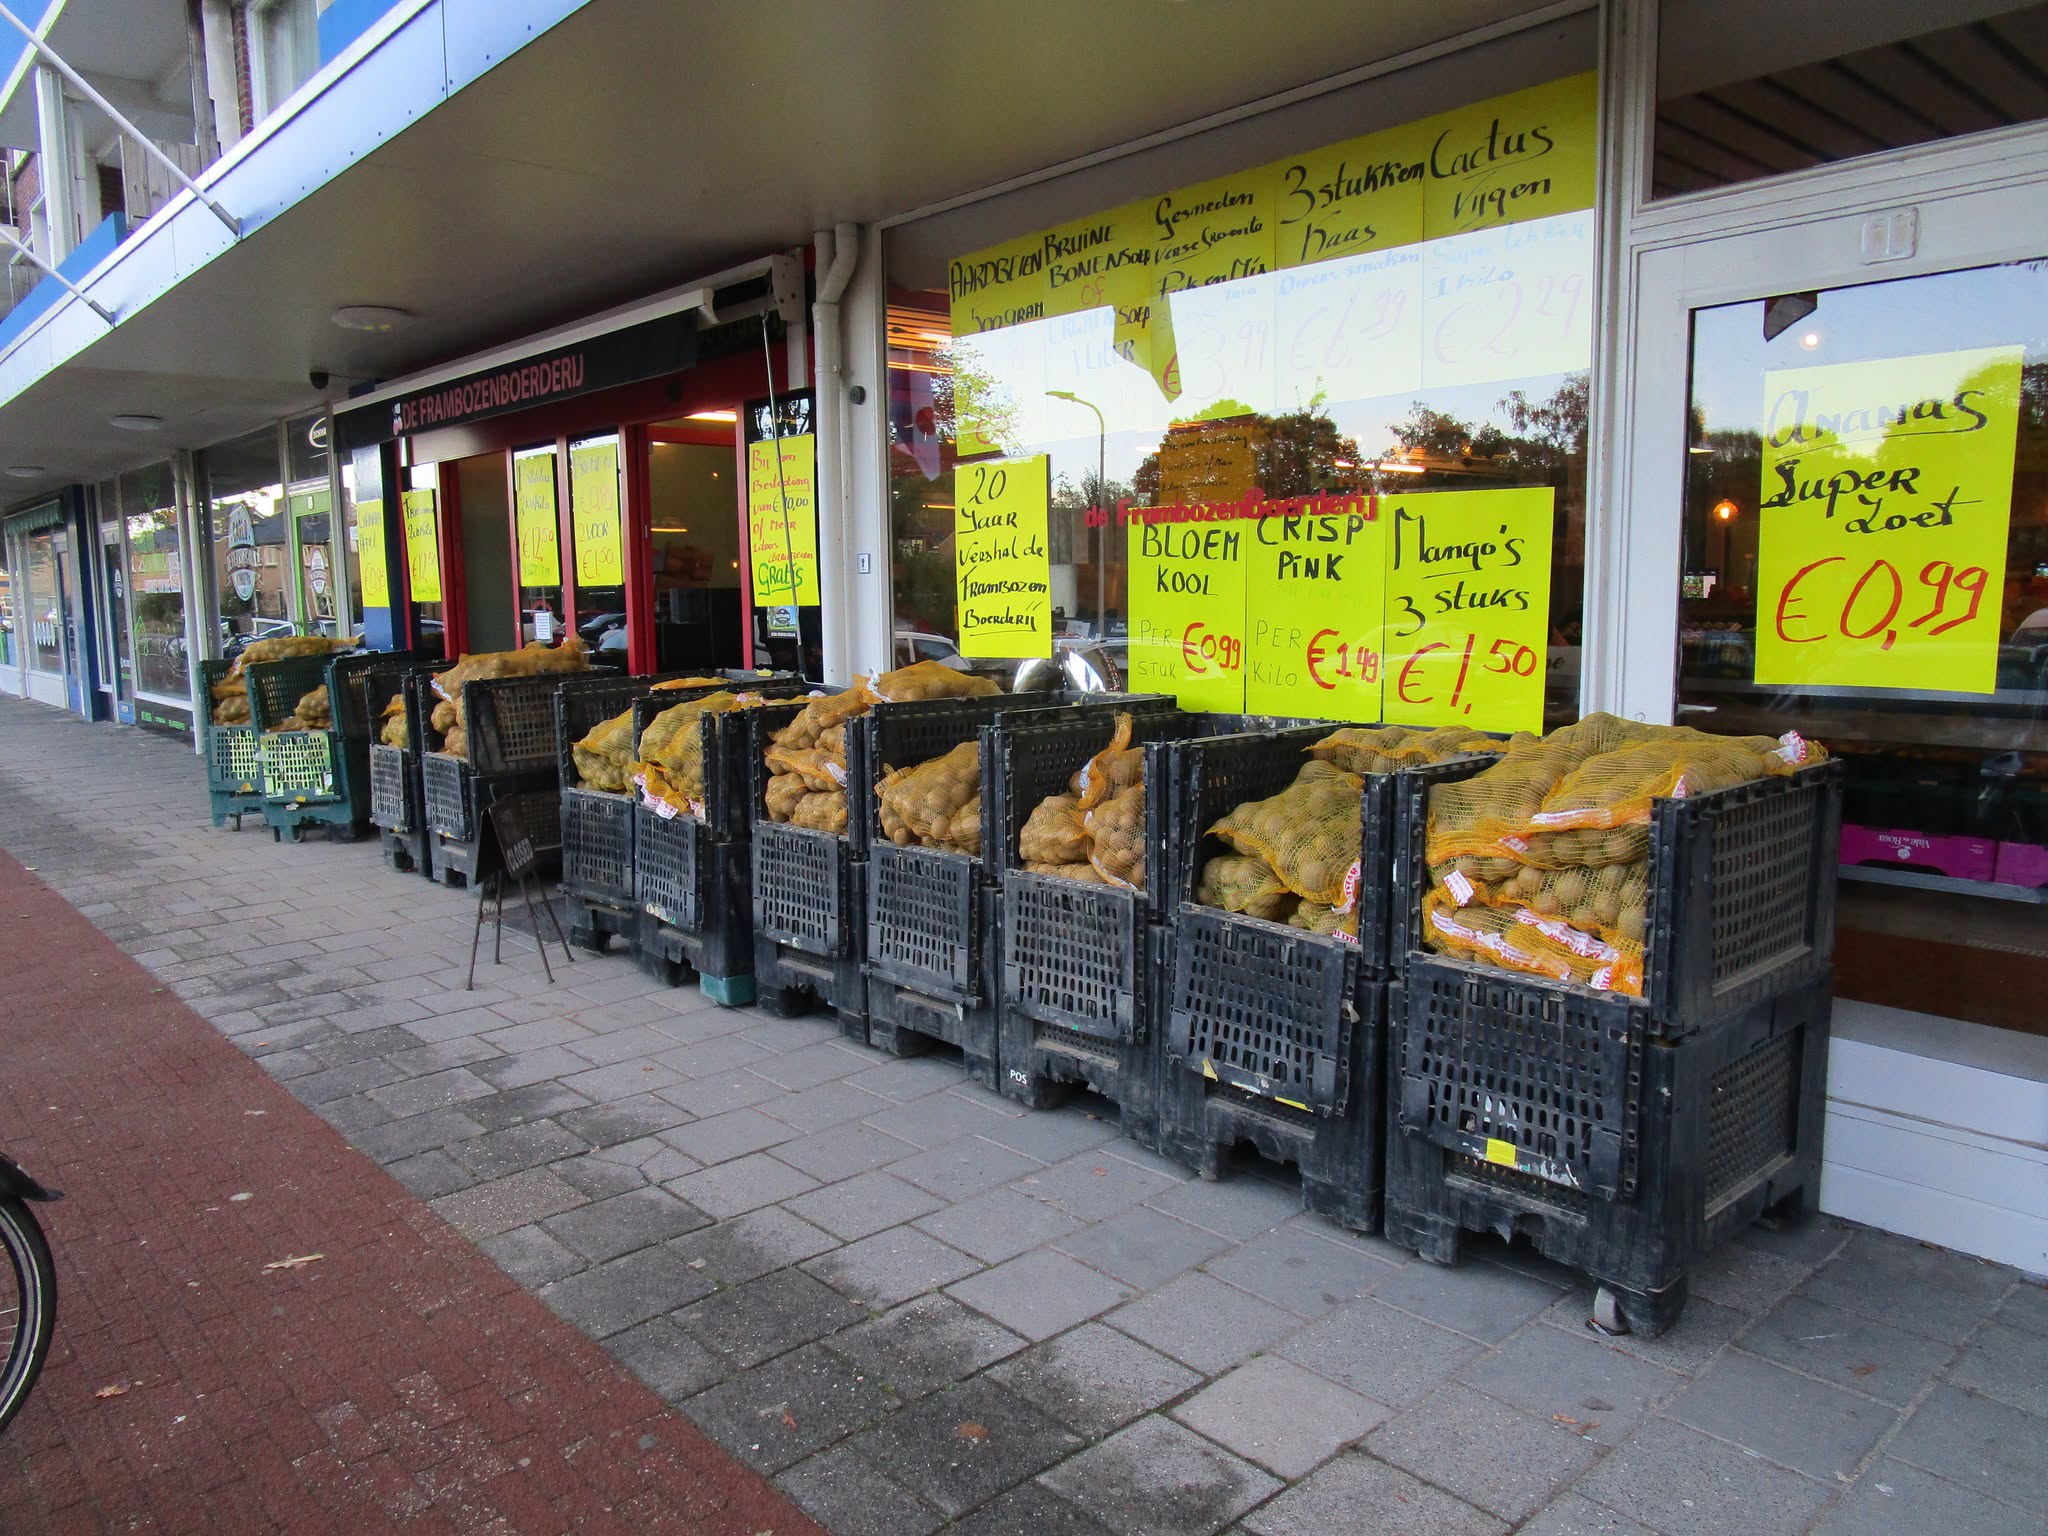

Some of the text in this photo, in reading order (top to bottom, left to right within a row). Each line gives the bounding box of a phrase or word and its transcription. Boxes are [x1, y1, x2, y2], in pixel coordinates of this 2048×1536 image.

[1430, 118, 1554, 179] Cactus
[1280, 165, 1316, 224] 3
[1300, 210, 1377, 262] Kaas
[401, 352, 585, 430] DE FRAMBOZENBOERDERIJ
[968, 466, 1007, 505] 20
[1084, 504, 1109, 528] de
[1393, 506, 1526, 572] Mango's
[1141, 523, 1241, 563] BLOEM
[1156, 565, 1220, 597] KOOL
[1775, 555, 1991, 652] €0,99
[1394, 580, 1531, 637] 3 stuks
[1139, 619, 1174, 648] PER
[1255, 619, 1303, 649] PER
[1397, 633, 1538, 715] €1,50
[506, 837, 534, 873] CLOSED
[1009, 1068, 1028, 1086] POS
